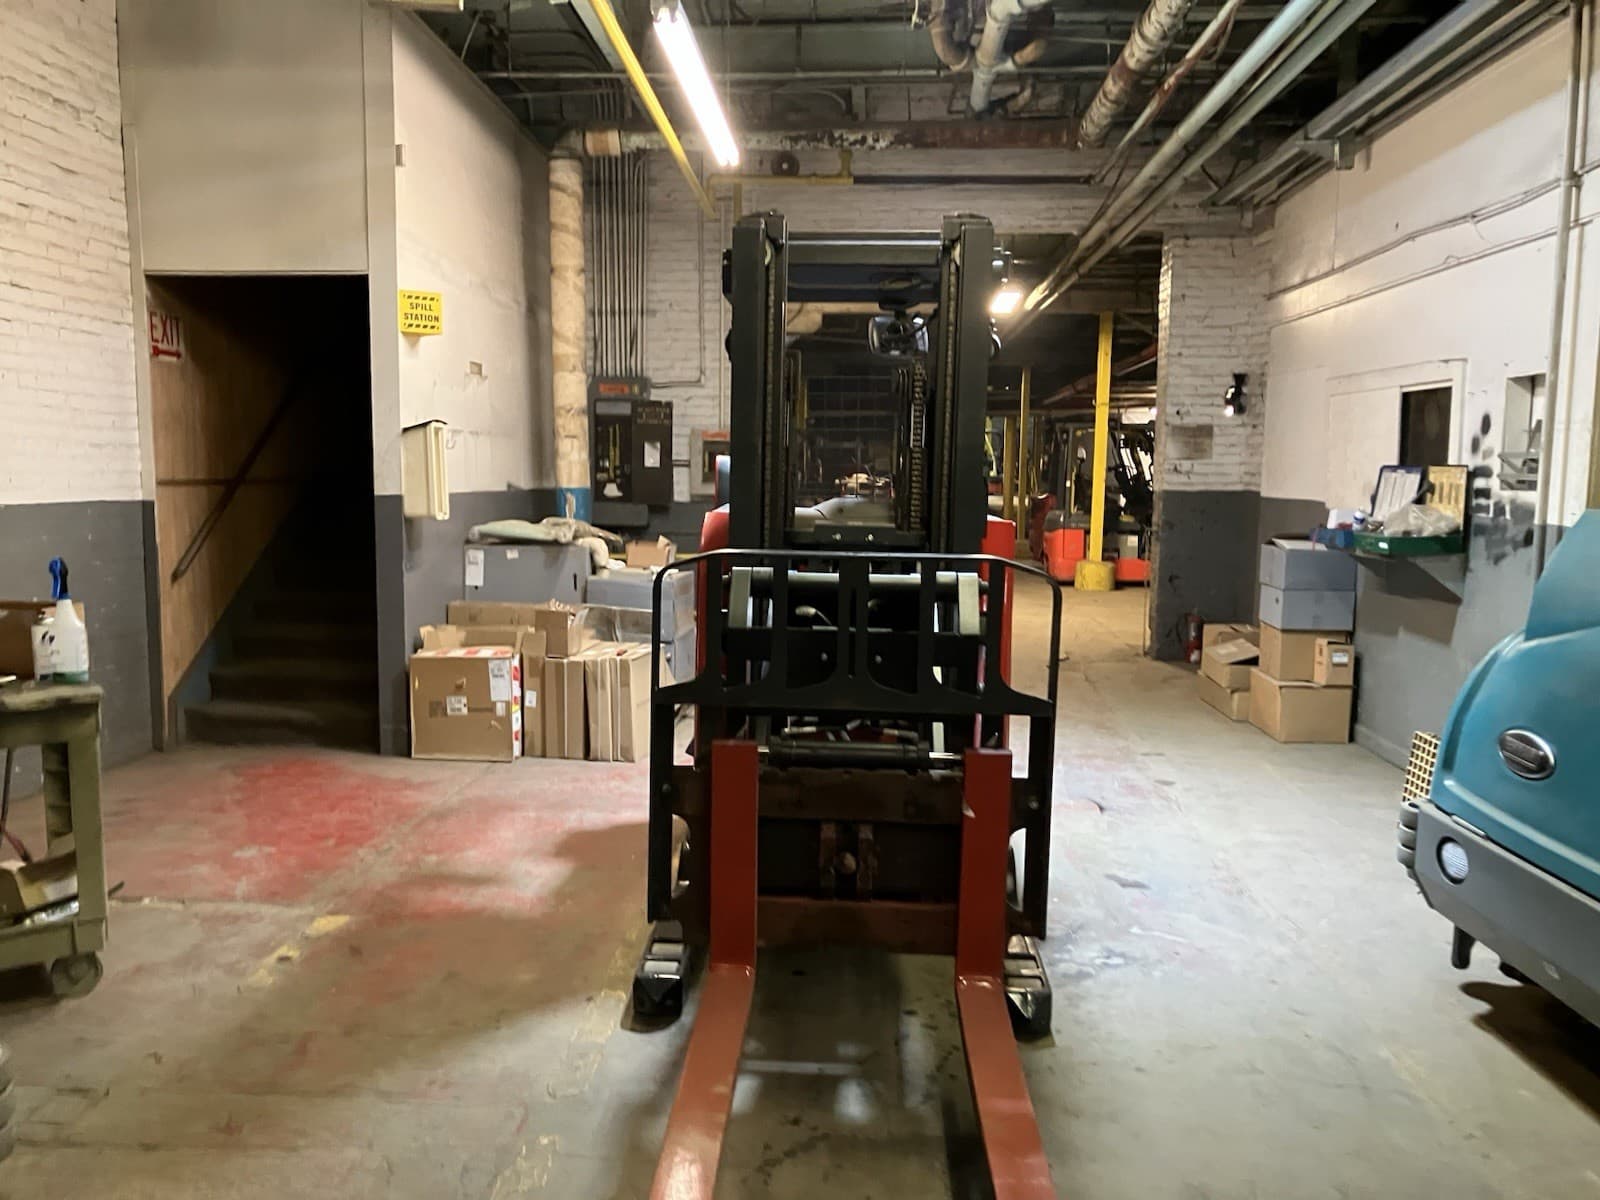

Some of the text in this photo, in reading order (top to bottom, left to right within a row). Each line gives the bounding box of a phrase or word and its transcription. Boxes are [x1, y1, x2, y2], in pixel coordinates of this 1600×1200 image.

[409, 302, 433, 311] SPILL
[404, 312, 439, 322] STATION
[149, 311, 181, 347] EXIT
